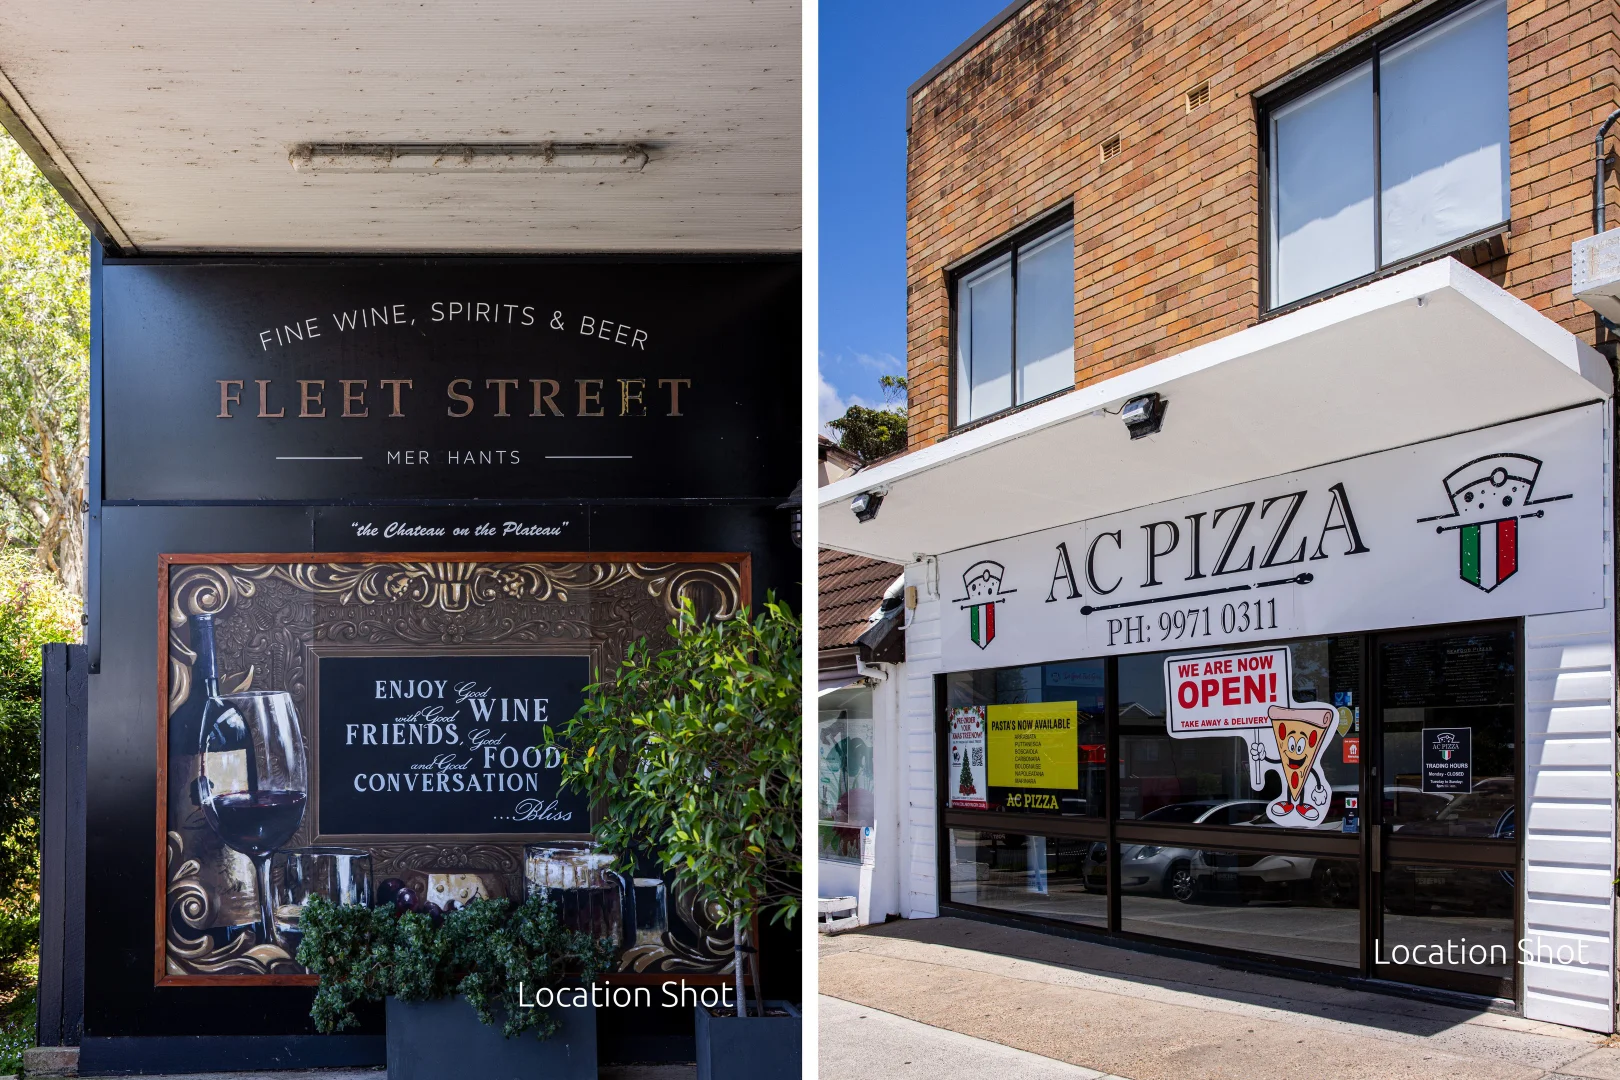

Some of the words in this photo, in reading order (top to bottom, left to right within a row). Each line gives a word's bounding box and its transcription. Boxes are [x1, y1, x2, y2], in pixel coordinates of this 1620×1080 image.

[259, 317, 321, 351] FINE
[332, 304, 416, 331] WINE,
[430, 301, 535, 326] SPIRITS
[549, 310, 566, 331] &
[579, 315, 649, 351] BEER
[215, 379, 413, 419] FLEET
[447, 377, 692, 418] STREET
[383, 521, 446, 539] Chateau
[452, 527, 472, 538] on
[474, 522, 497, 538] the
[1045, 529, 1123, 602] AC
[1140, 482, 1370, 588] PIZZA
[1106, 615, 1151, 647] PH:
[1158, 606, 1212, 641] 9971
[1220, 597, 1279, 634] 0311
[1177, 663, 1199, 678] WE
[1203, 660, 1233, 676] ARE
[1237, 655, 1274, 672] NOW
[374, 680, 448, 699] ENJOY
[454, 681, 492, 704] Good
[1177, 672, 1277, 709] OPEN!
[394, 711, 418, 724] with
[417, 705, 460, 728] Good
[467, 698, 549, 722] WINE
[991, 720, 1016, 731] PASTA'S
[1018, 719, 1034, 731] NOW
[1034, 718, 1071, 730] AVAILABLE
[1181, 720, 1199, 728] TAKE
[1201, 719, 1221, 727] AWAY
[1223, 718, 1229, 726] &
[1231, 716, 1269, 725] DELIVERY
[346, 723, 464, 747] FRIENDS,
[467, 729, 507, 751] Good
[410, 757, 434, 771] and
[433, 754, 473, 774] Good
[483, 746, 561, 769] FOOD
[353, 773, 539, 793] CONVERSATION
[1006, 793, 1022, 807] AC
[1023, 793, 1060, 809] PIZZA
